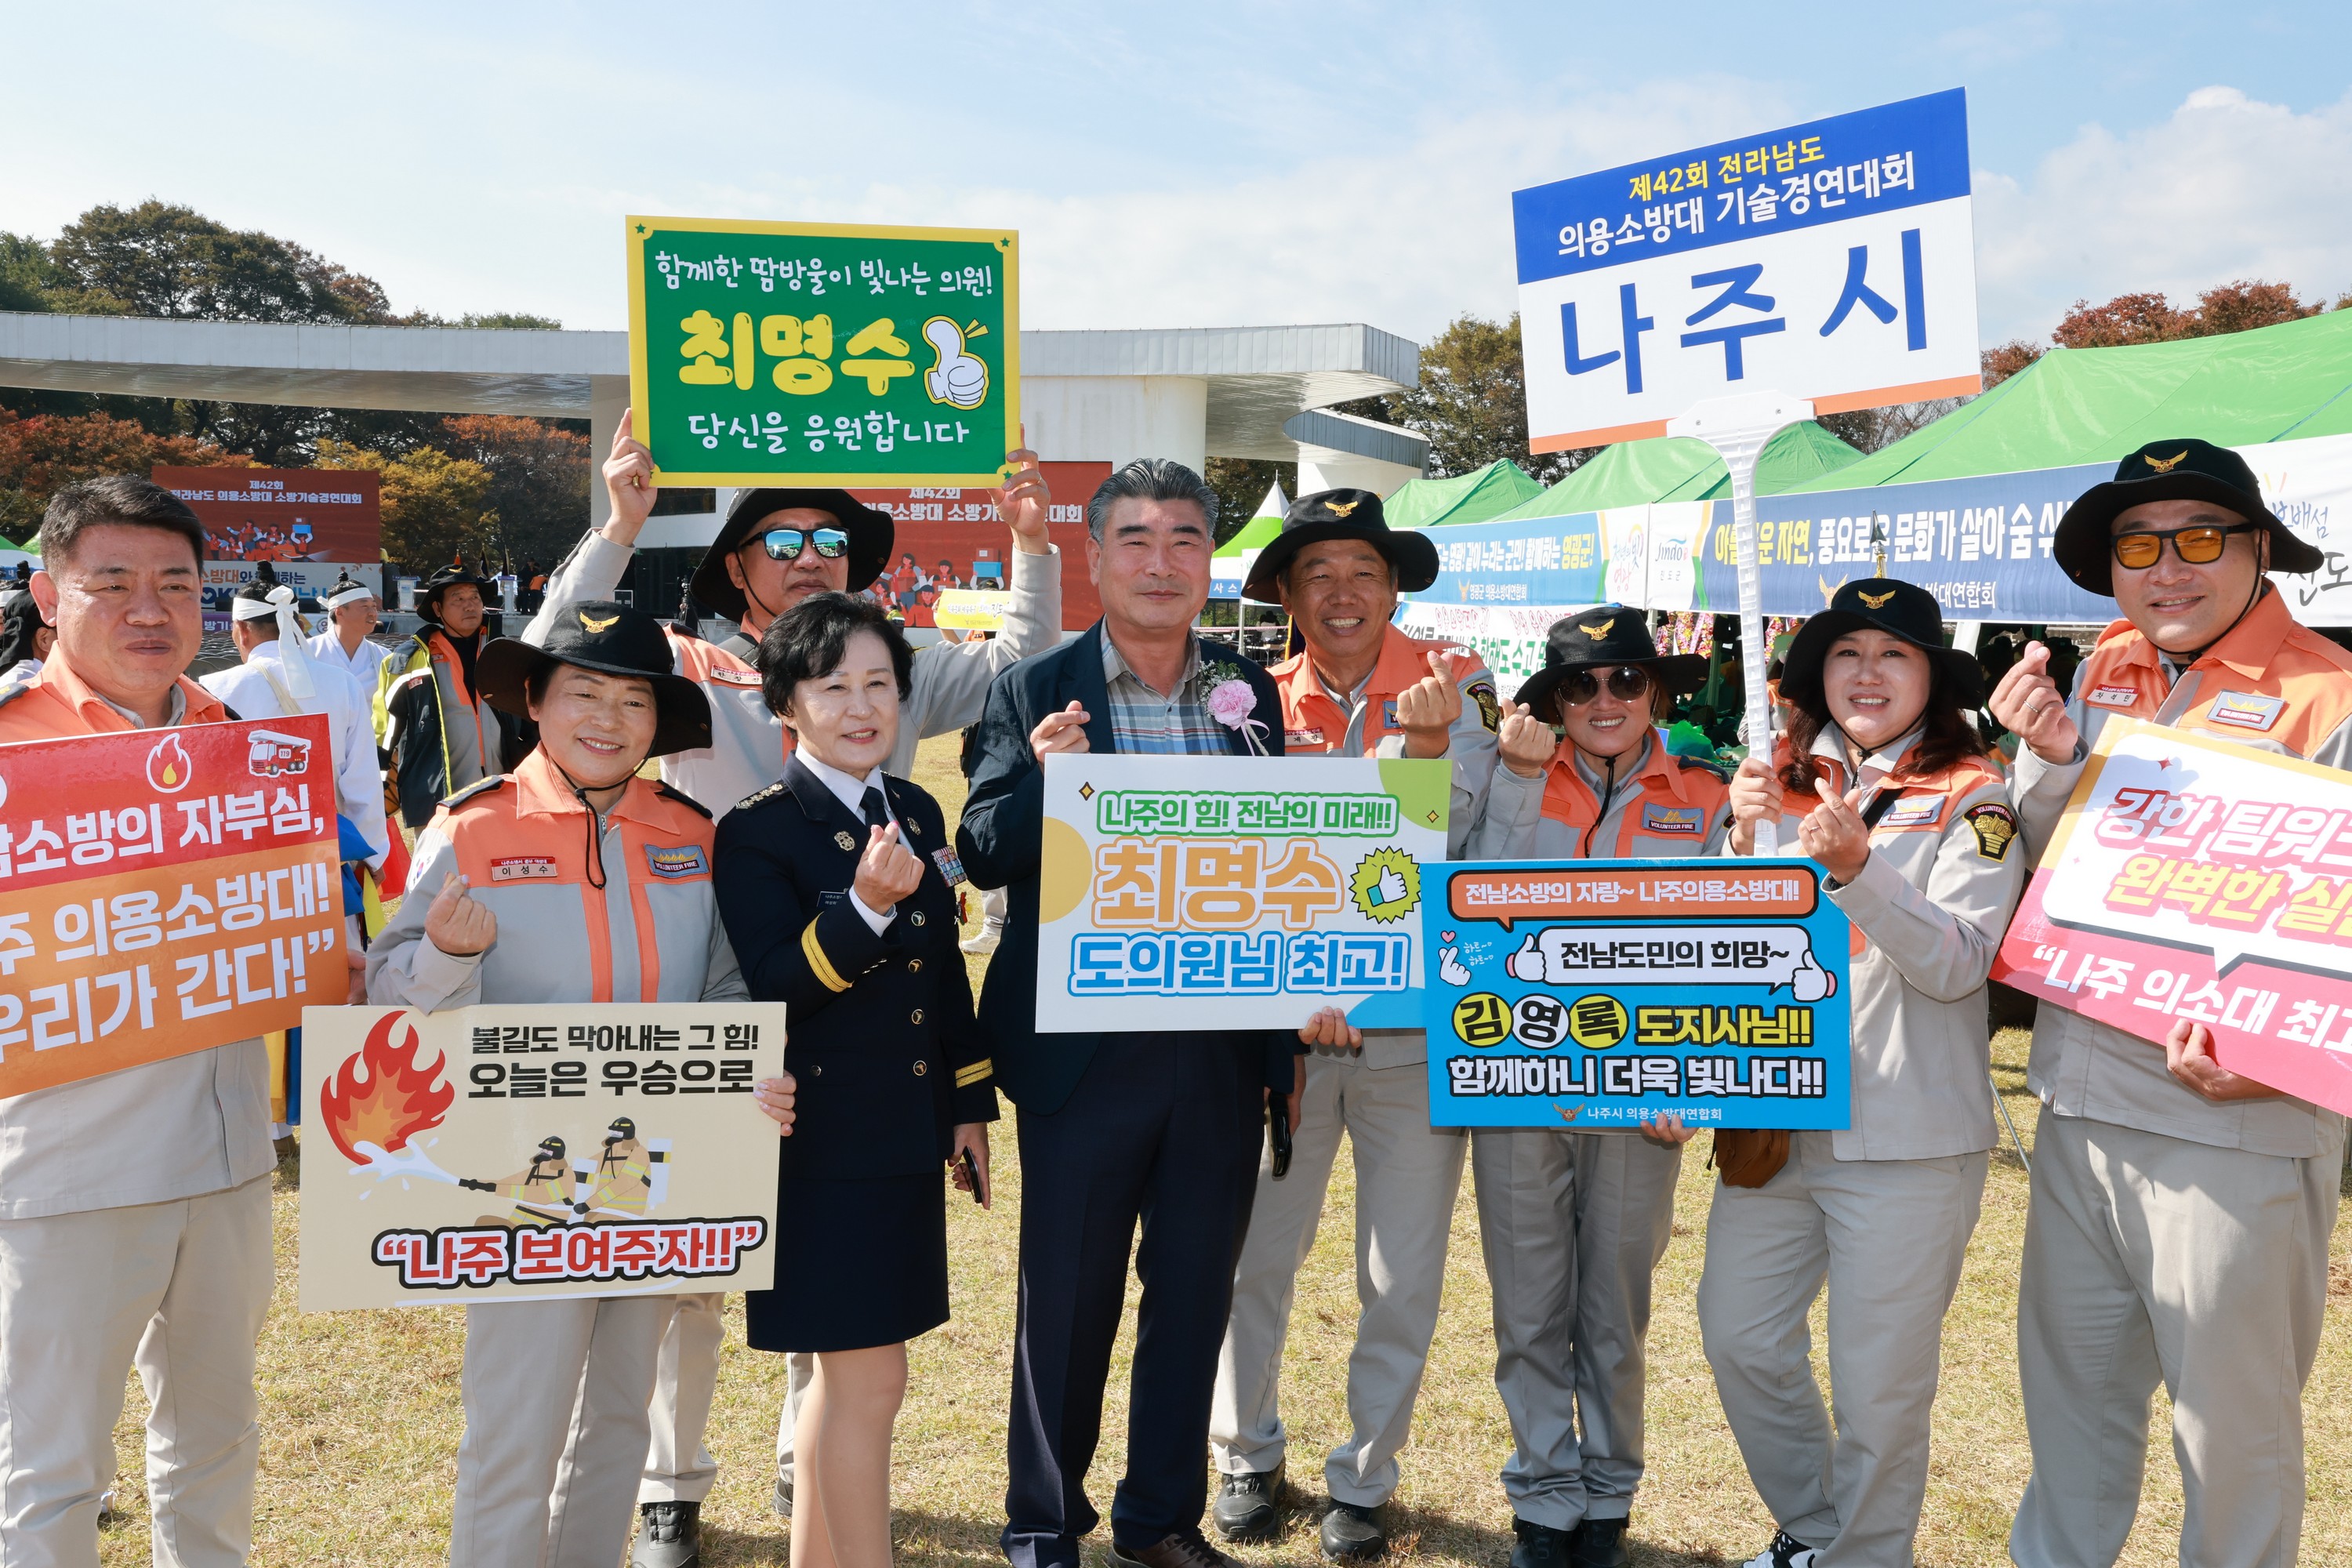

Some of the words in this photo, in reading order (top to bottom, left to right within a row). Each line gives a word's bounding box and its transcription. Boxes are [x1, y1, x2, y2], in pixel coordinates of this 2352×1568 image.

[1629, 160, 1708, 201] 제42회
[1719, 136, 1825, 184] 전라남도
[1559, 197, 1704, 258] 의용소방대
[1717, 151, 1915, 224] 기술경연대회
[655, 251, 742, 289] 함께한
[750, 256, 851, 295] 땀방울이
[860, 259, 931, 296] 빛나는
[939, 266, 993, 297] 의원!
[679, 310, 915, 396] 최명수
[688, 412, 789, 454] 당신을
[804, 411, 969, 452] 응원합니다
[218, 491, 272, 502] 의용소방대
[275, 492, 362, 504] 소방기술경연대회
[249, 480, 283, 490] 제42회
[1894, 510, 1956, 561] 문화가
[1961, 506, 2005, 561] 살아
[177, 784, 324, 849] 자부심,
[1105, 798, 1187, 828] 나주의
[1194, 800, 1229, 828] 힘!
[1236, 800, 1316, 829] 전남의
[1323, 801, 1391, 829] 미래!!
[1890, 811, 1919, 820] VOLUNTEER
[1976, 805, 2005, 814] VOLUNTEER
[2099, 790, 2217, 844] 강한
[1101, 845, 1336, 925] 최명수
[1466, 884, 1570, 906] 전남소방의
[1577, 883, 1635, 903] 자랑~
[1639, 880, 1798, 902] 나주의용소방대!
[2107, 858, 2284, 923] 완벽한
[54, 862, 330, 963] 의용소방대!
[1076, 939, 1274, 989] 도의원님
[1292, 940, 1401, 986] 최고!
[1561, 940, 1703, 969] 전남도민의
[1711, 940, 1789, 968] 희망~
[2134, 970, 2280, 1034] 의소대
[472, 1026, 558, 1054] 불길도
[568, 1025, 680, 1052] 막아내는
[688, 1025, 715, 1051] 그
[724, 1024, 758, 1050] 힘!
[1638, 1007, 1810, 1044] 도지사님!!
[468, 1062, 587, 1098] 오늘은
[601, 1059, 753, 1096] 우승으로
[1450, 1058, 1595, 1094] 함께하니
[1606, 1058, 1678, 1094] 더욱
[1588, 1107, 1622, 1120] 나주시
[383, 1233, 503, 1279] “나주
